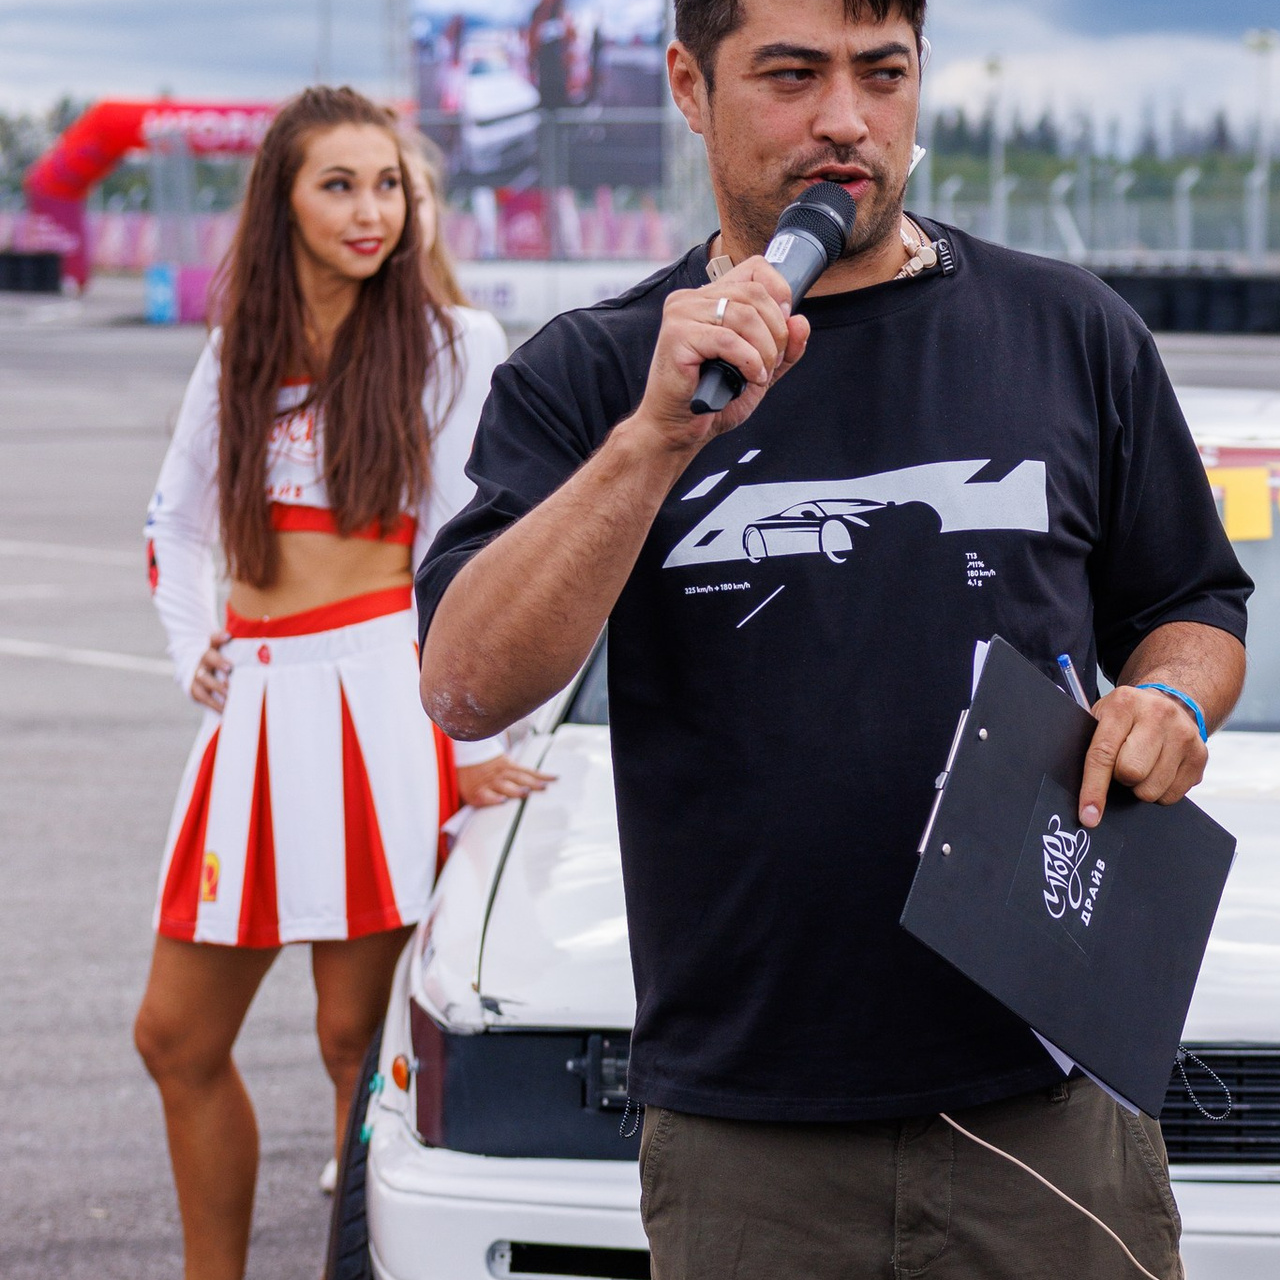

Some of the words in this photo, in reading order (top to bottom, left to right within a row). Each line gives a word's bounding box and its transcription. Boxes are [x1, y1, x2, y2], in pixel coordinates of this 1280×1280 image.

[965, 552, 978, 560] T13
[979, 569, 996, 578] km/h
[684, 587, 696, 595] 325
[696, 585, 714, 593] km/h
[720, 583, 733, 591] 180
[733, 581, 751, 590] km/h
[1080, 858, 1106, 927] ДРАЙВ
